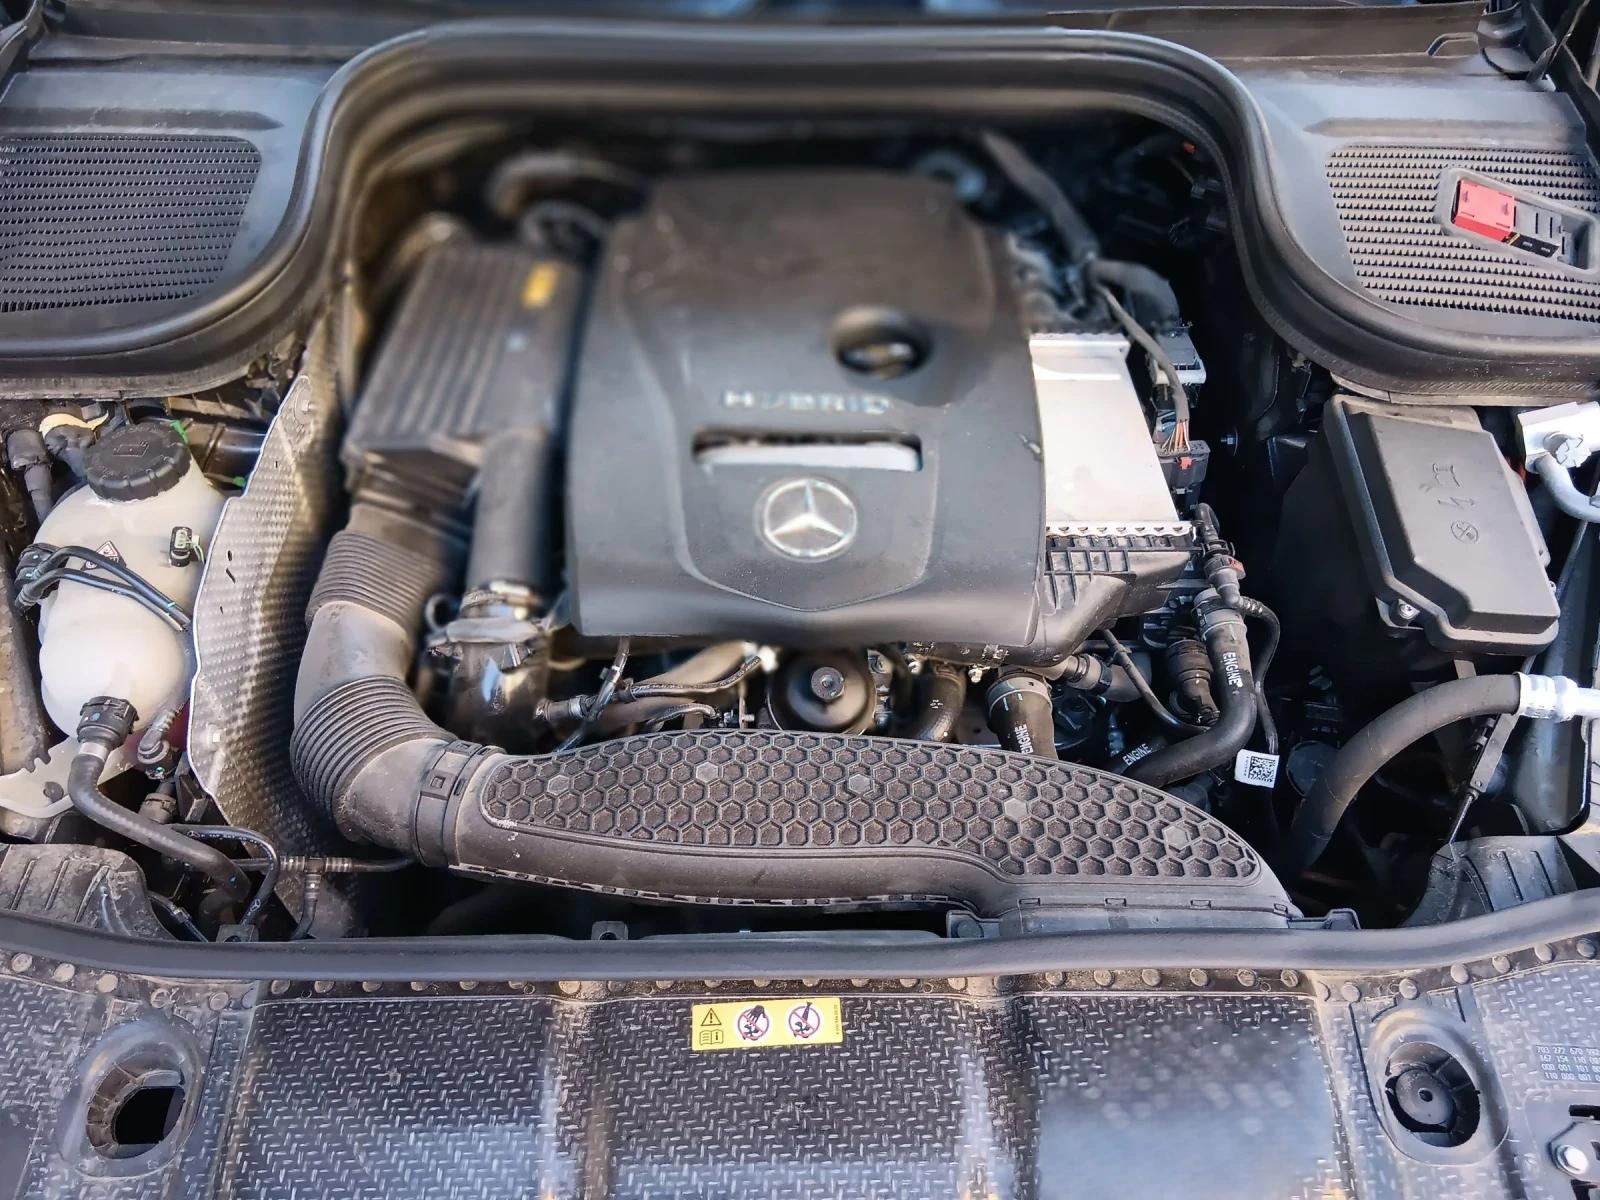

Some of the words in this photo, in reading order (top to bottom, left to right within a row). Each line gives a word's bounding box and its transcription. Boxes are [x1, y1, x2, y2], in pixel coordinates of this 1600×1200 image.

[1223, 651, 1243, 687] ENGINE
[1014, 723, 1034, 754] ENGINE
[1122, 743, 1151, 766] ENGINE
[1536, 1046, 1550, 1054] 703
